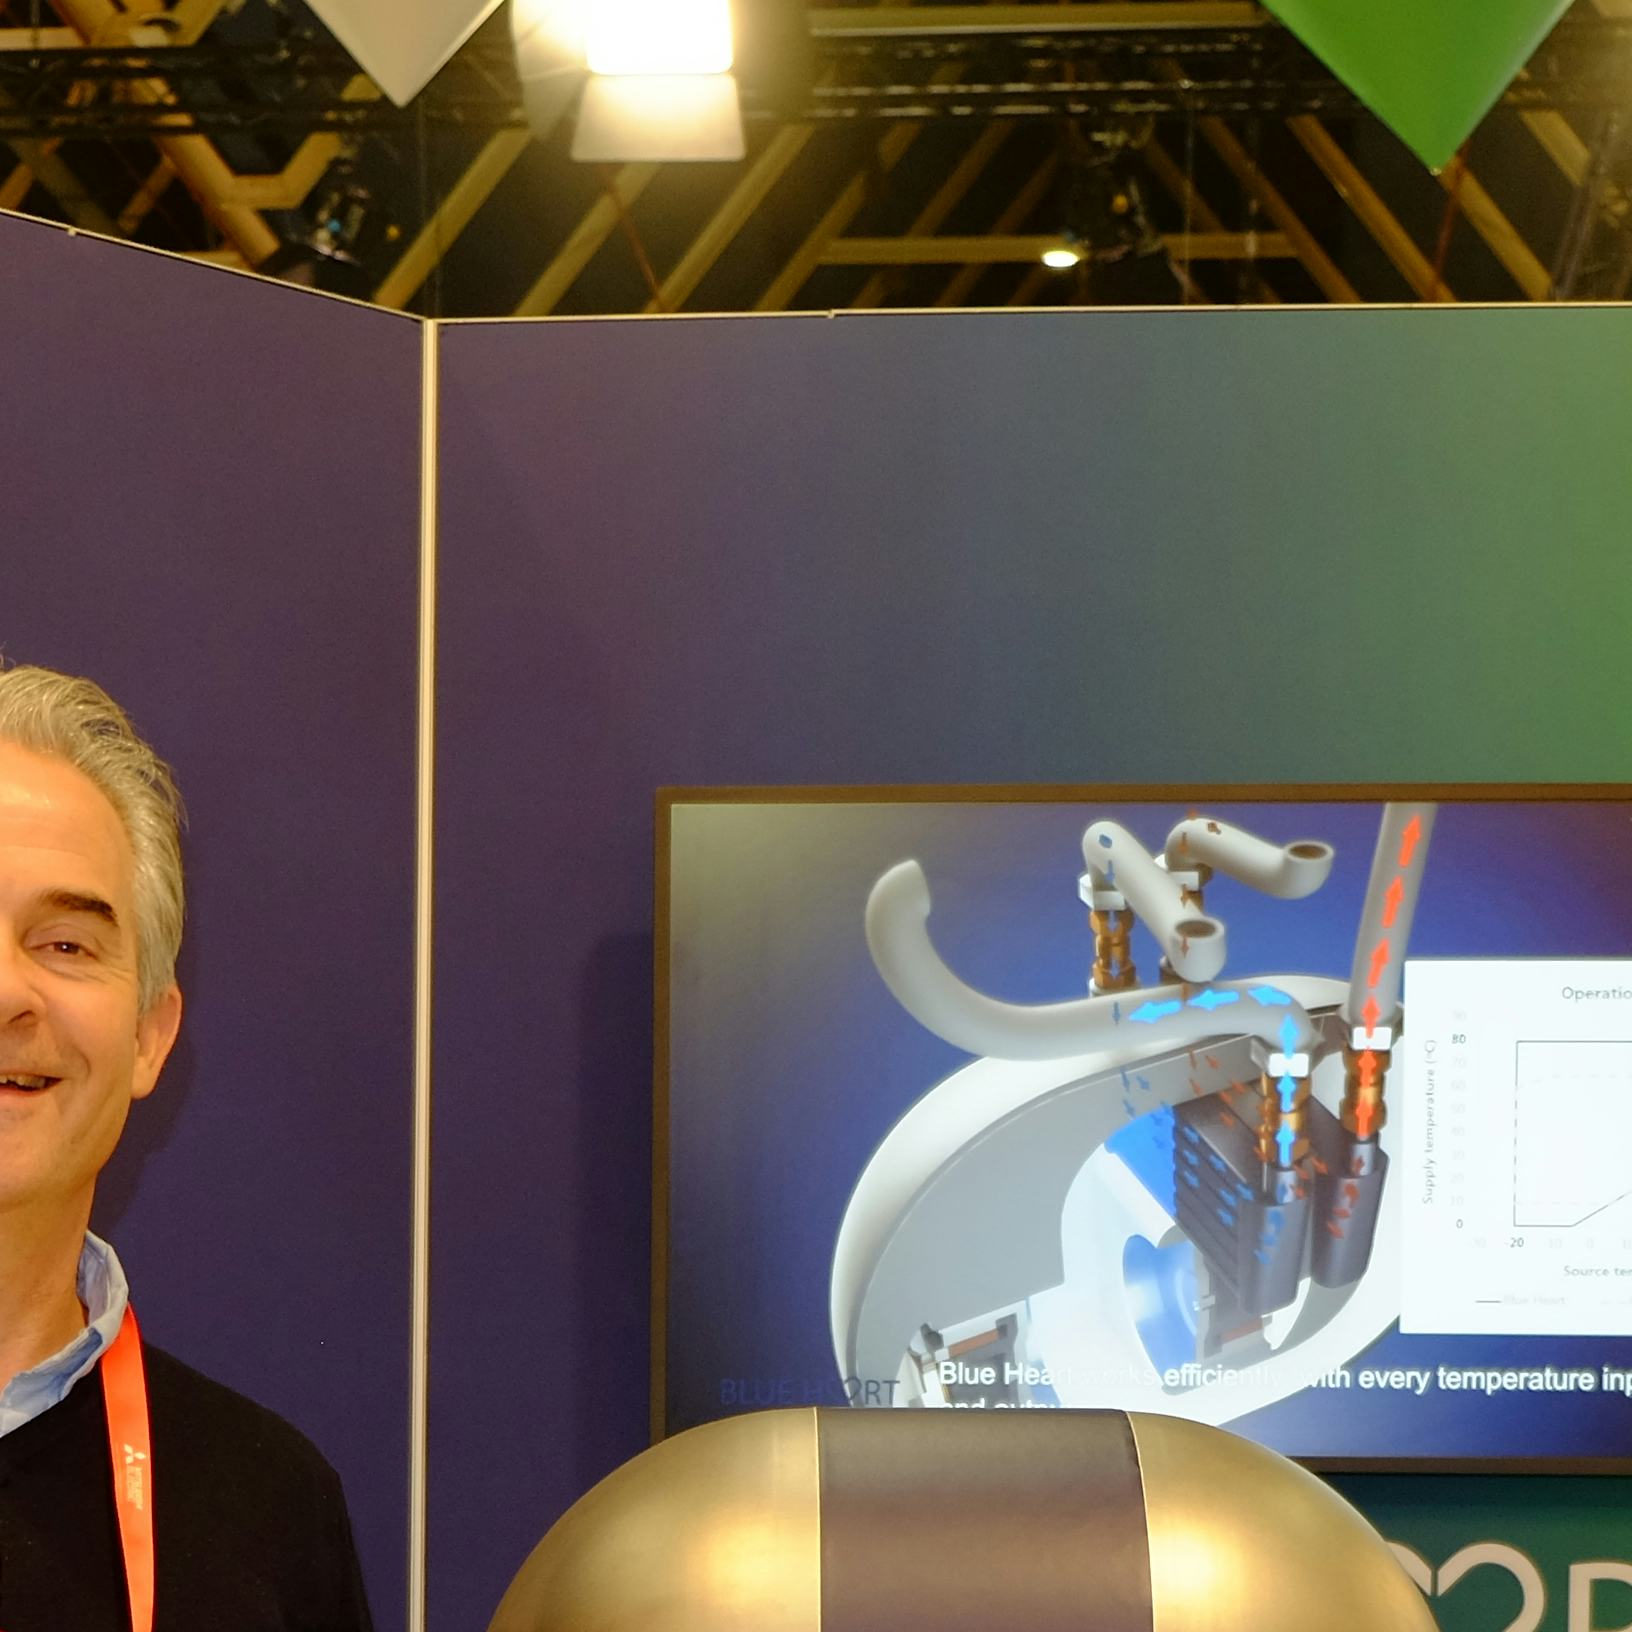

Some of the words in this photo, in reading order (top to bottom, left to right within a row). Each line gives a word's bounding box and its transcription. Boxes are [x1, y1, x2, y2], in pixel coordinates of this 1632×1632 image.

[1425, 1069, 1440, 1147] temperature
[1423, 1150, 1440, 1206] Supply
[1563, 1265, 1610, 1278] Source
[939, 1361, 995, 1385] Blue
[1004, 1361, 1073, 1385] Heart
[1358, 1368, 1430, 1395] every
[1437, 1365, 1595, 1397] temperature
